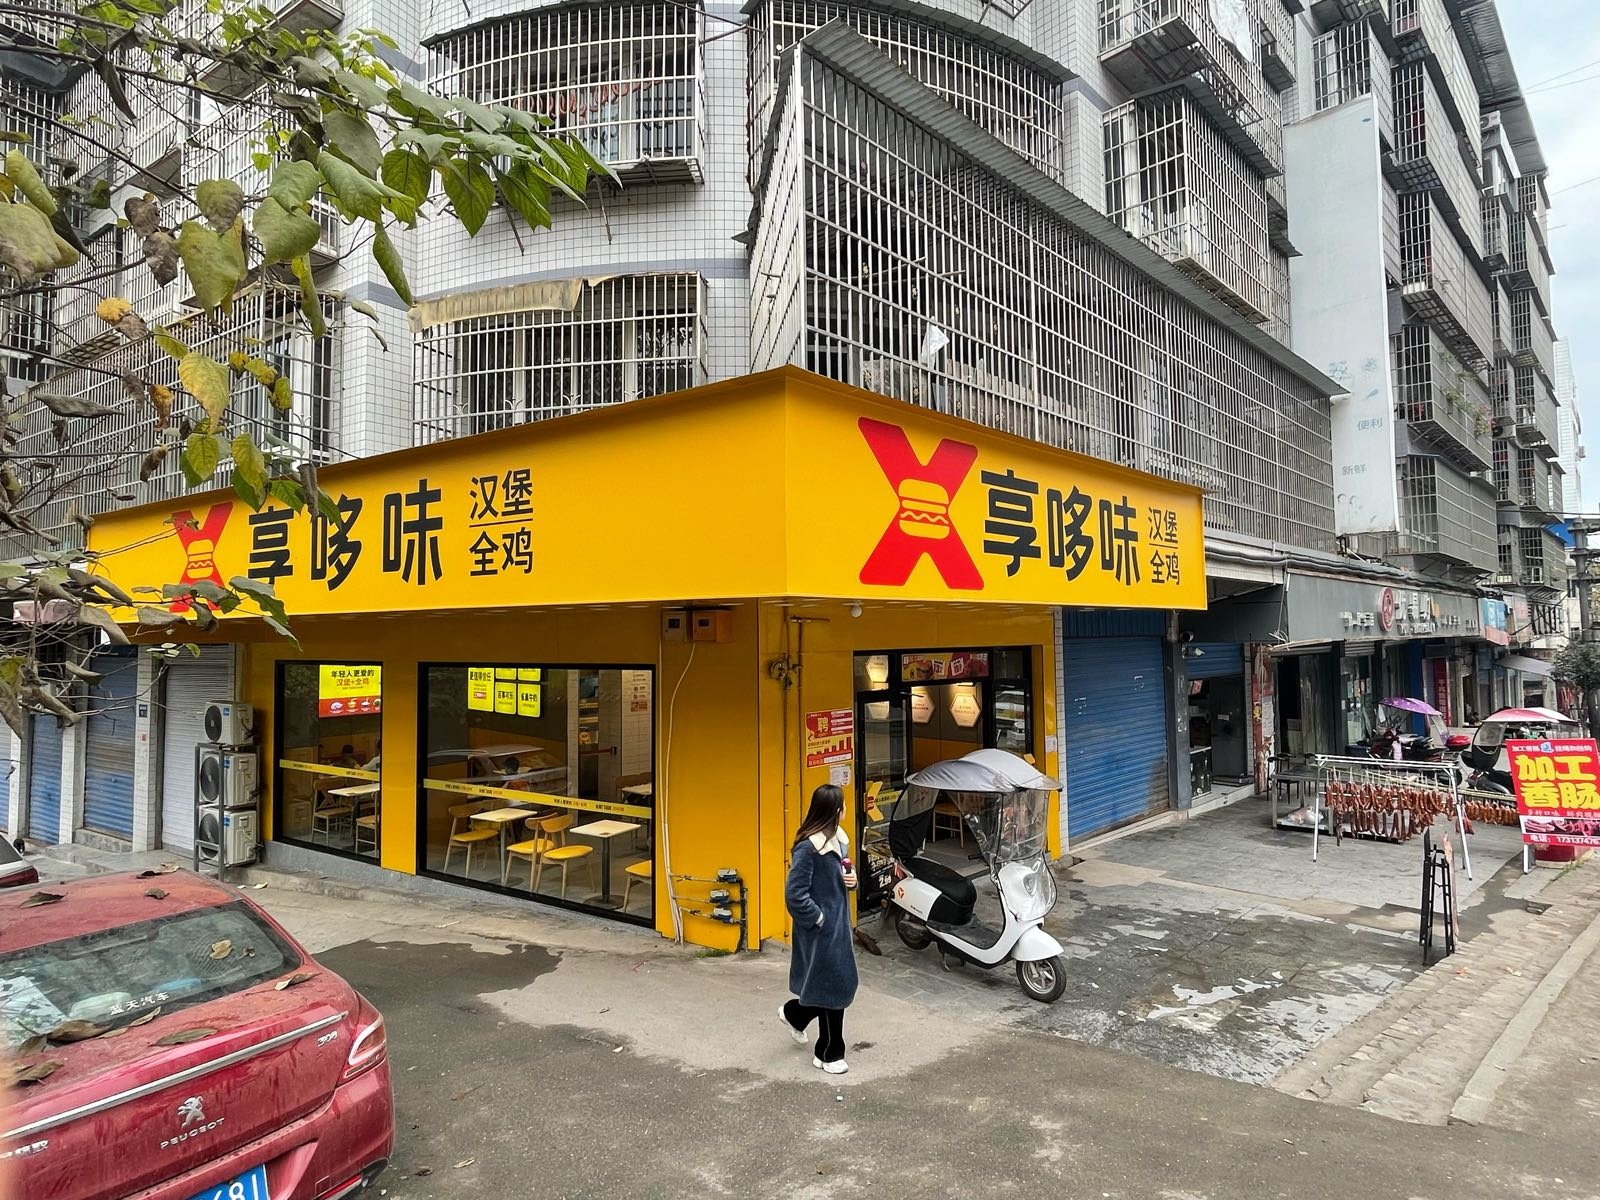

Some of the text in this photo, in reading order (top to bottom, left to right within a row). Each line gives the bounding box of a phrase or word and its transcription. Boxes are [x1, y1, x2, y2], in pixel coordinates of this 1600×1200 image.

[1357, 417, 1383, 431] 便利
[1342, 464, 1367, 476] 新鲜
[470, 468, 534, 521] 汉堡
[247, 478, 444, 592] 享哆味
[980, 469, 1140, 586] 享哆味
[1148, 506, 1179, 543] 汉堡
[470, 526, 534, 577] 全鸡
[1149, 551, 1180, 586] 全鸡
[331, 669, 375, 678] 年轻人更爱的
[336, 677, 370, 687] 汉堡+全鸡
[1515, 754, 1597, 781] 加工
[1520, 781, 1600, 810] 香肠
[110, 991, 170, 1016] 蓝天汽车
[317, 1030, 338, 1048] 308
[160, 1116, 225, 1150] PEUGEOT
